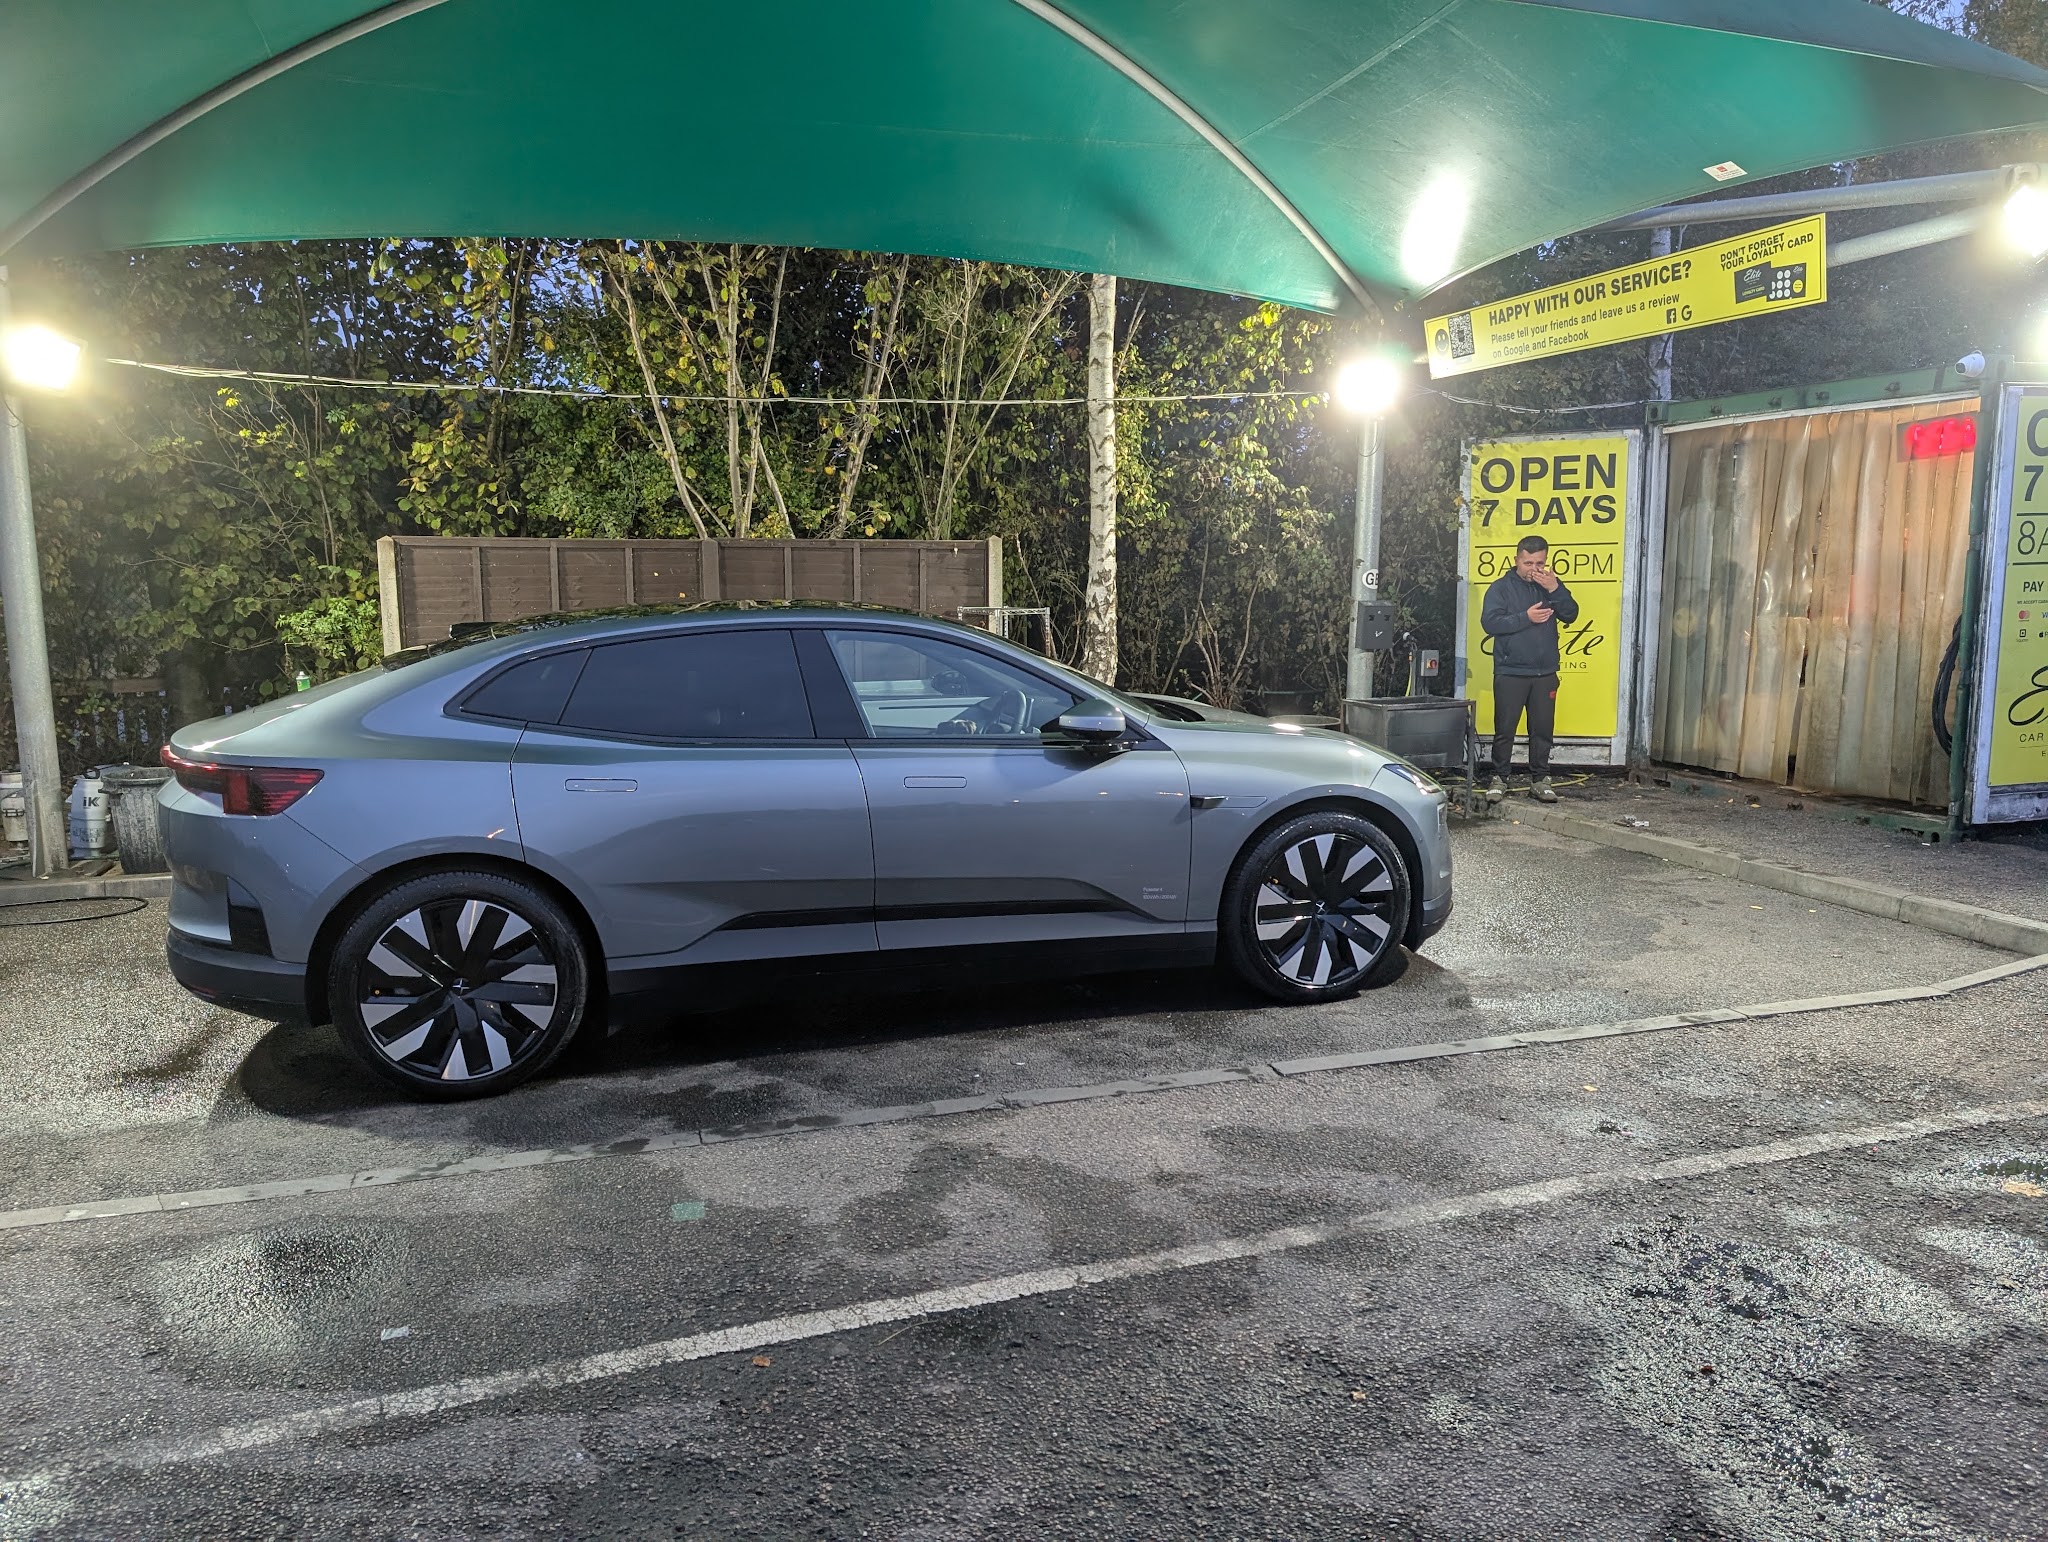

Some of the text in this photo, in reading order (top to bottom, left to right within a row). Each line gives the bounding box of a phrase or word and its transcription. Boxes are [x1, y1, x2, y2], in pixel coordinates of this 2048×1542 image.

[1720, 232, 1785, 262] DON'T FORGET
[1721, 232, 1814, 271] YOUR LOYALTY CARD
[1488, 260, 1692, 326] HAPPY WITH OUR SERVICE?
[1491, 293, 1680, 344] Please tell your friends and leave us a review
[1492, 329, 1589, 358] on Google and Facebook
[1480, 453, 1617, 494] OPEN
[2023, 465, 2044, 502] 7
[1480, 494, 1617, 527] 7 DAYS
[2022, 580, 2045, 593] PAY
[2019, 732, 2044, 743] CAR
